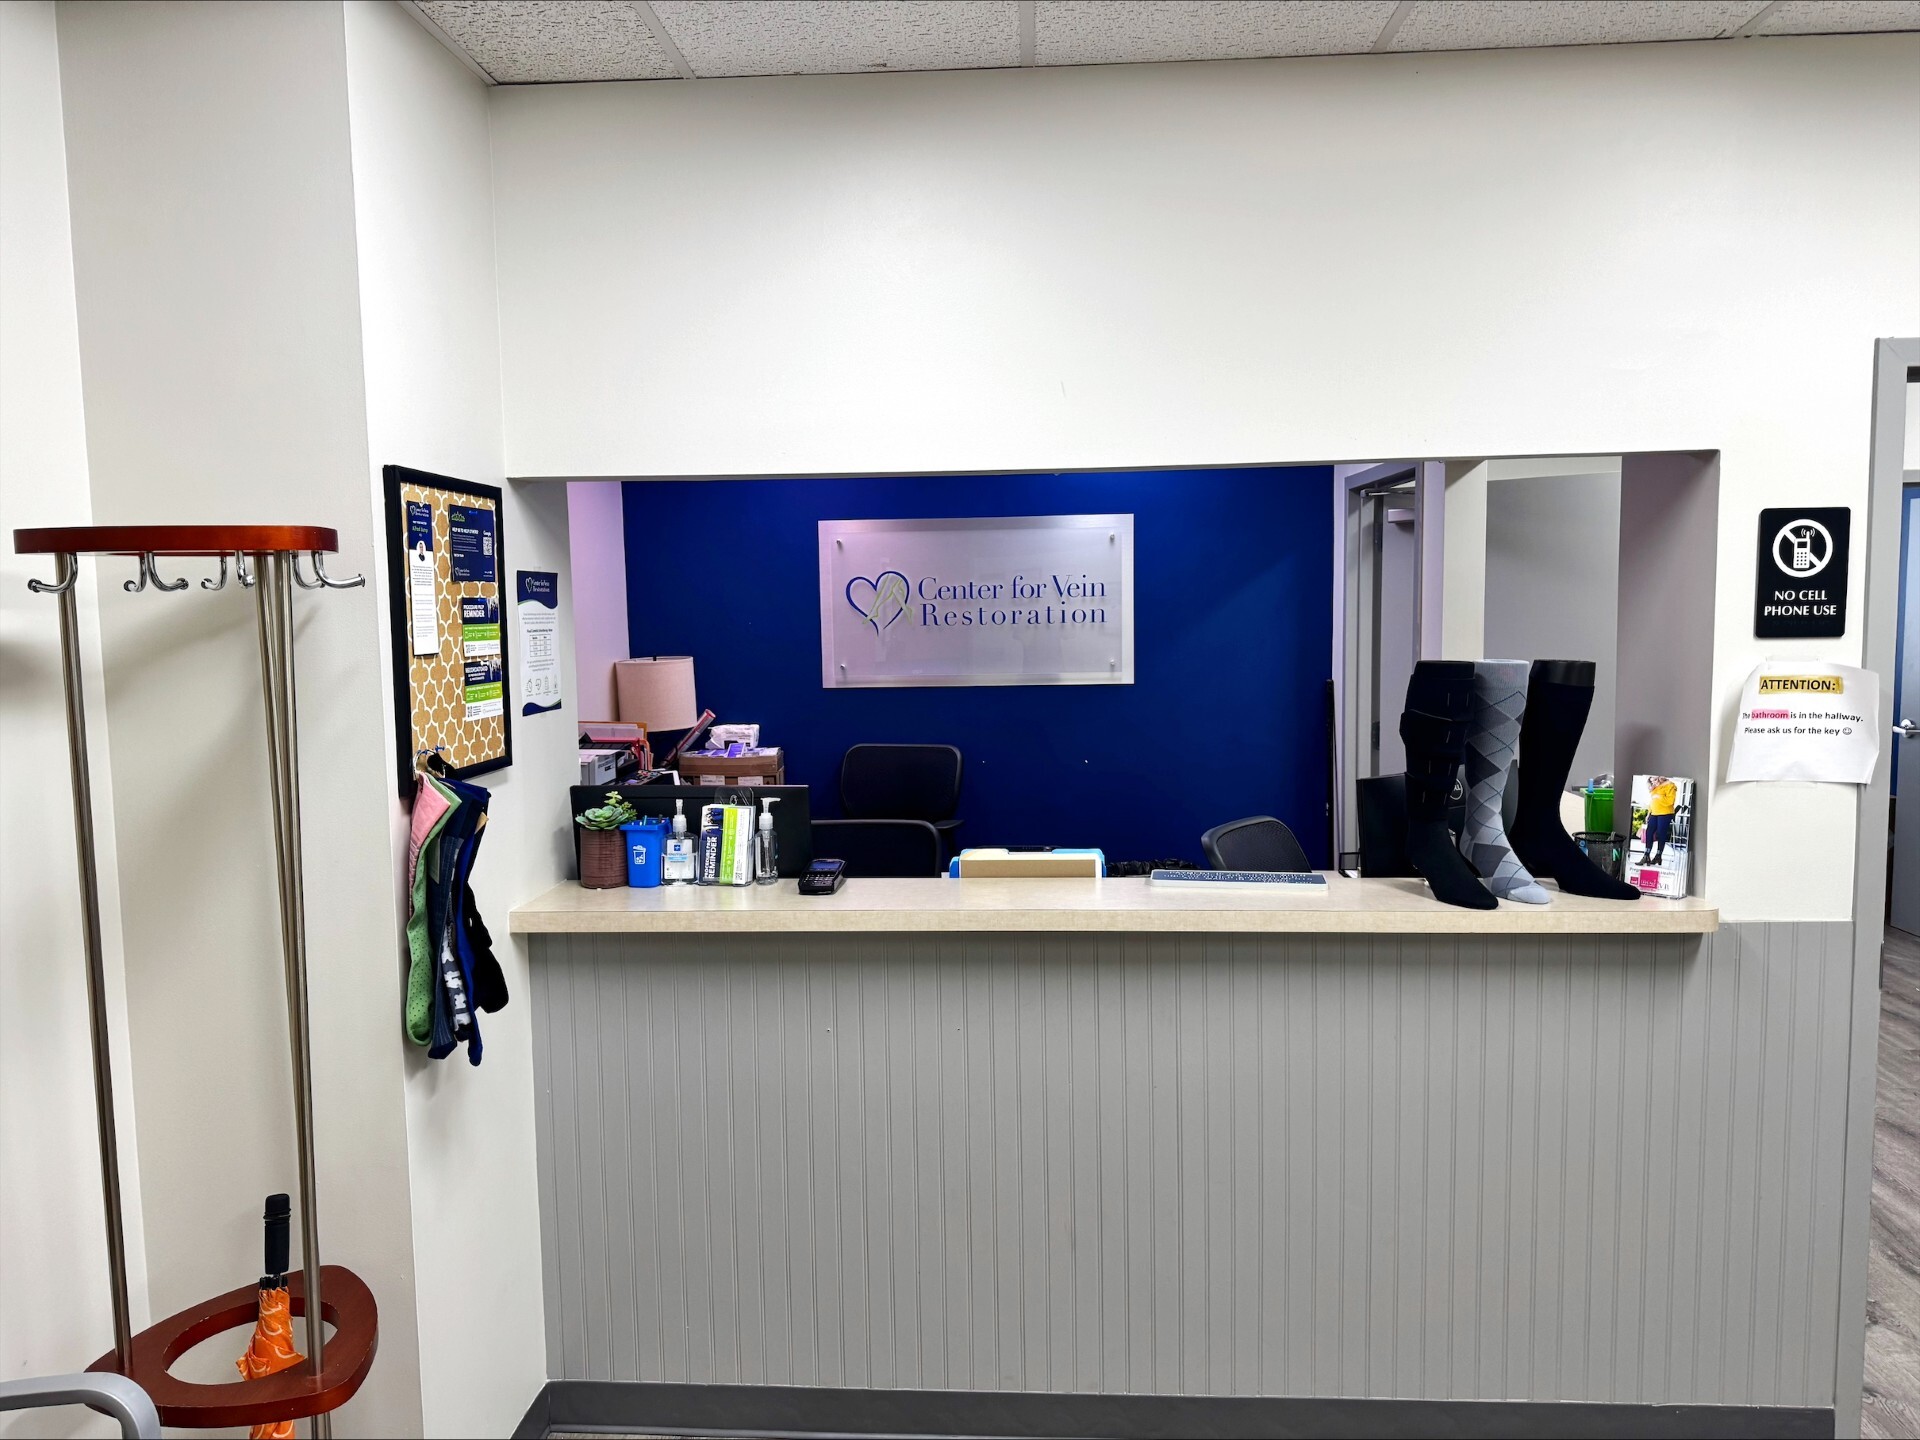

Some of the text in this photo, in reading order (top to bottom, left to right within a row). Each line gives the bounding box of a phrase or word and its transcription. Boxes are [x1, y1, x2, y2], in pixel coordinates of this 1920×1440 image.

[918, 575, 1107, 600] Center for Vein
[1774, 590, 1827, 601] NO CELL
[919, 601, 1107, 626] Restoration
[1764, 605, 1837, 616] PHONE USE
[1760, 679, 1836, 691] ATTENTION:
[1751, 711, 1789, 719] bathroom
[1790, 711, 1797, 719] is
[1798, 711, 1807, 719] in
[1808, 711, 1823, 719] the
[1824, 711, 1864, 723] hallway.
[1744, 726, 1840, 737] Please ask us for the key
[708, 836, 718, 879] REMINDER
